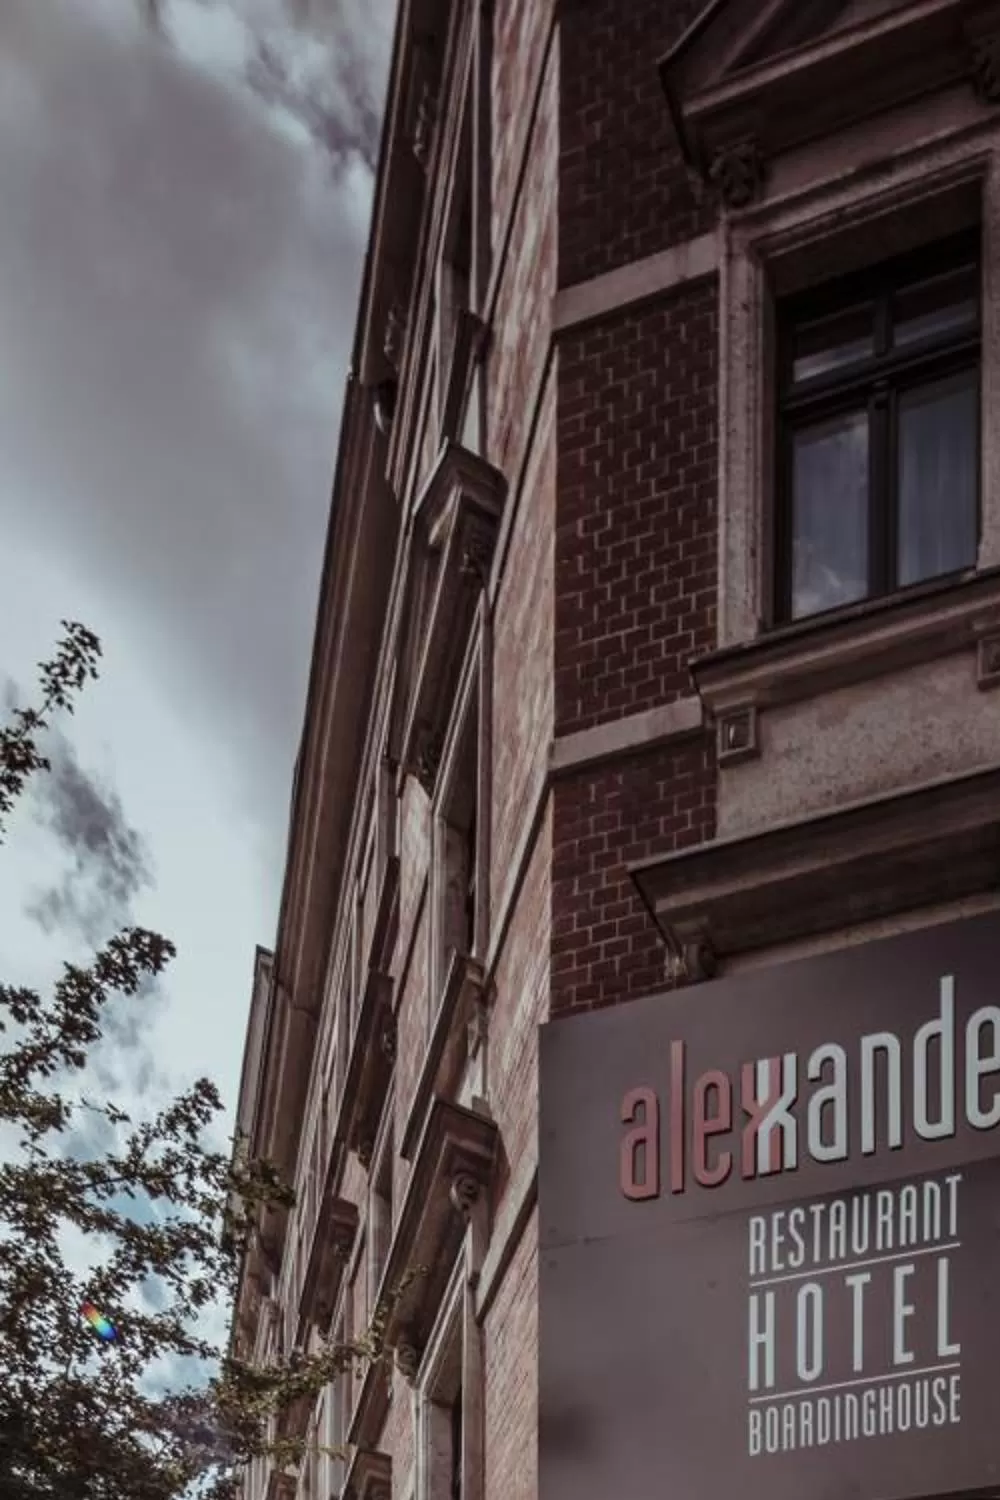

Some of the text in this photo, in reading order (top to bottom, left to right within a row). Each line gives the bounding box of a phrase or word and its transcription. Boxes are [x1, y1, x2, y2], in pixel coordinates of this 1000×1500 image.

[749, 1175, 962, 1276] RESTAURANT
[748, 1257, 961, 1391] HOTEL
[748, 1375, 961, 1457] BOARDINGHOUSE
